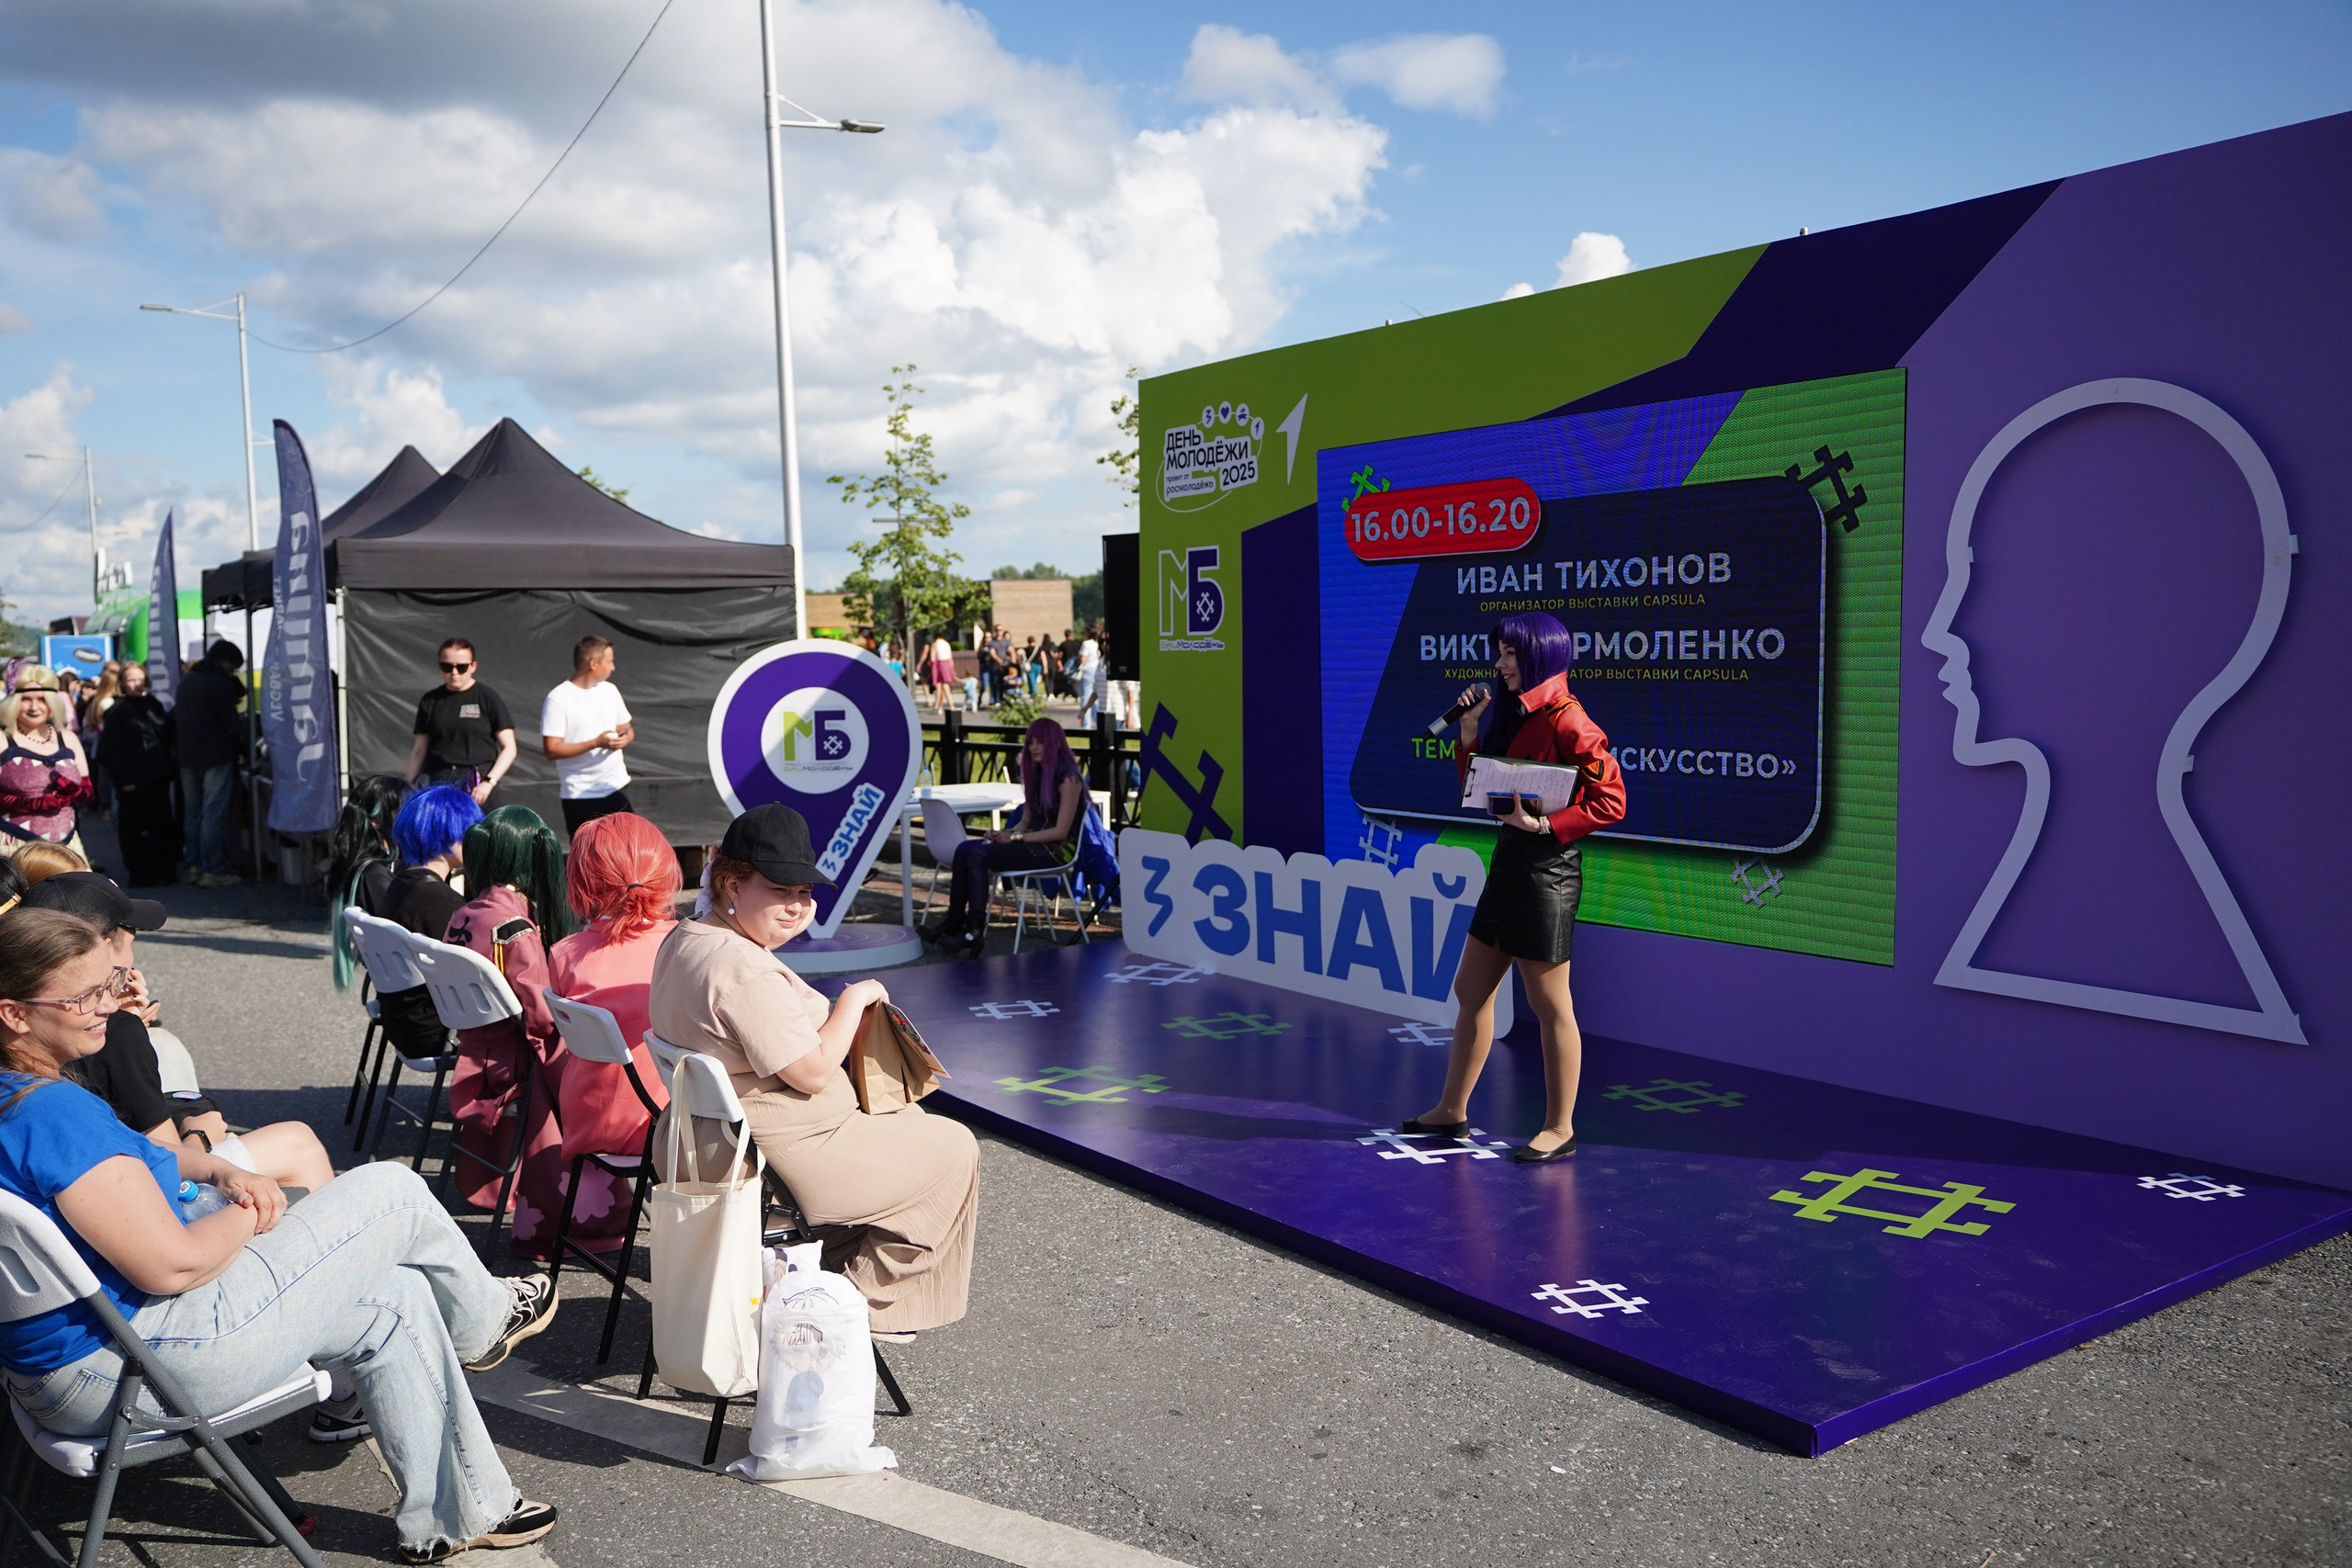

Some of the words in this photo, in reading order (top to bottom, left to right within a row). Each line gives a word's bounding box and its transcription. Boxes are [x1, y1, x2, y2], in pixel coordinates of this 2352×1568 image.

[1166, 429, 1202, 454] ДЕНЬ
[1166, 440, 1249, 471] МОЛОДЁЖИ
[1166, 474, 1183, 483] проект
[1222, 460, 1256, 486] 2025
[1351, 496, 1531, 543] 16.00-16.20
[1457, 563, 1544, 594] ИВАН
[1554, 551, 1732, 591] ТИХОНОВ
[1479, 599, 1566, 613] ОРГАНИЗАТОР
[1568, 595, 1639, 610] ВЫСТАВКИ
[1643, 593, 1706, 607] CAPSULA
[1572, 627, 1785, 660] РМОЛЕНКО
[1444, 668, 1498, 680] ХУДОЖНИ
[1606, 668, 1679, 680] ВЫСТАВКИ
[1684, 668, 1748, 680] CAPSULA
[1411, 738, 1456, 761] ТЕМ
[831, 787, 881, 859] ЗНАЙ
[1193, 863, 1476, 1003] ЗНАЙ
